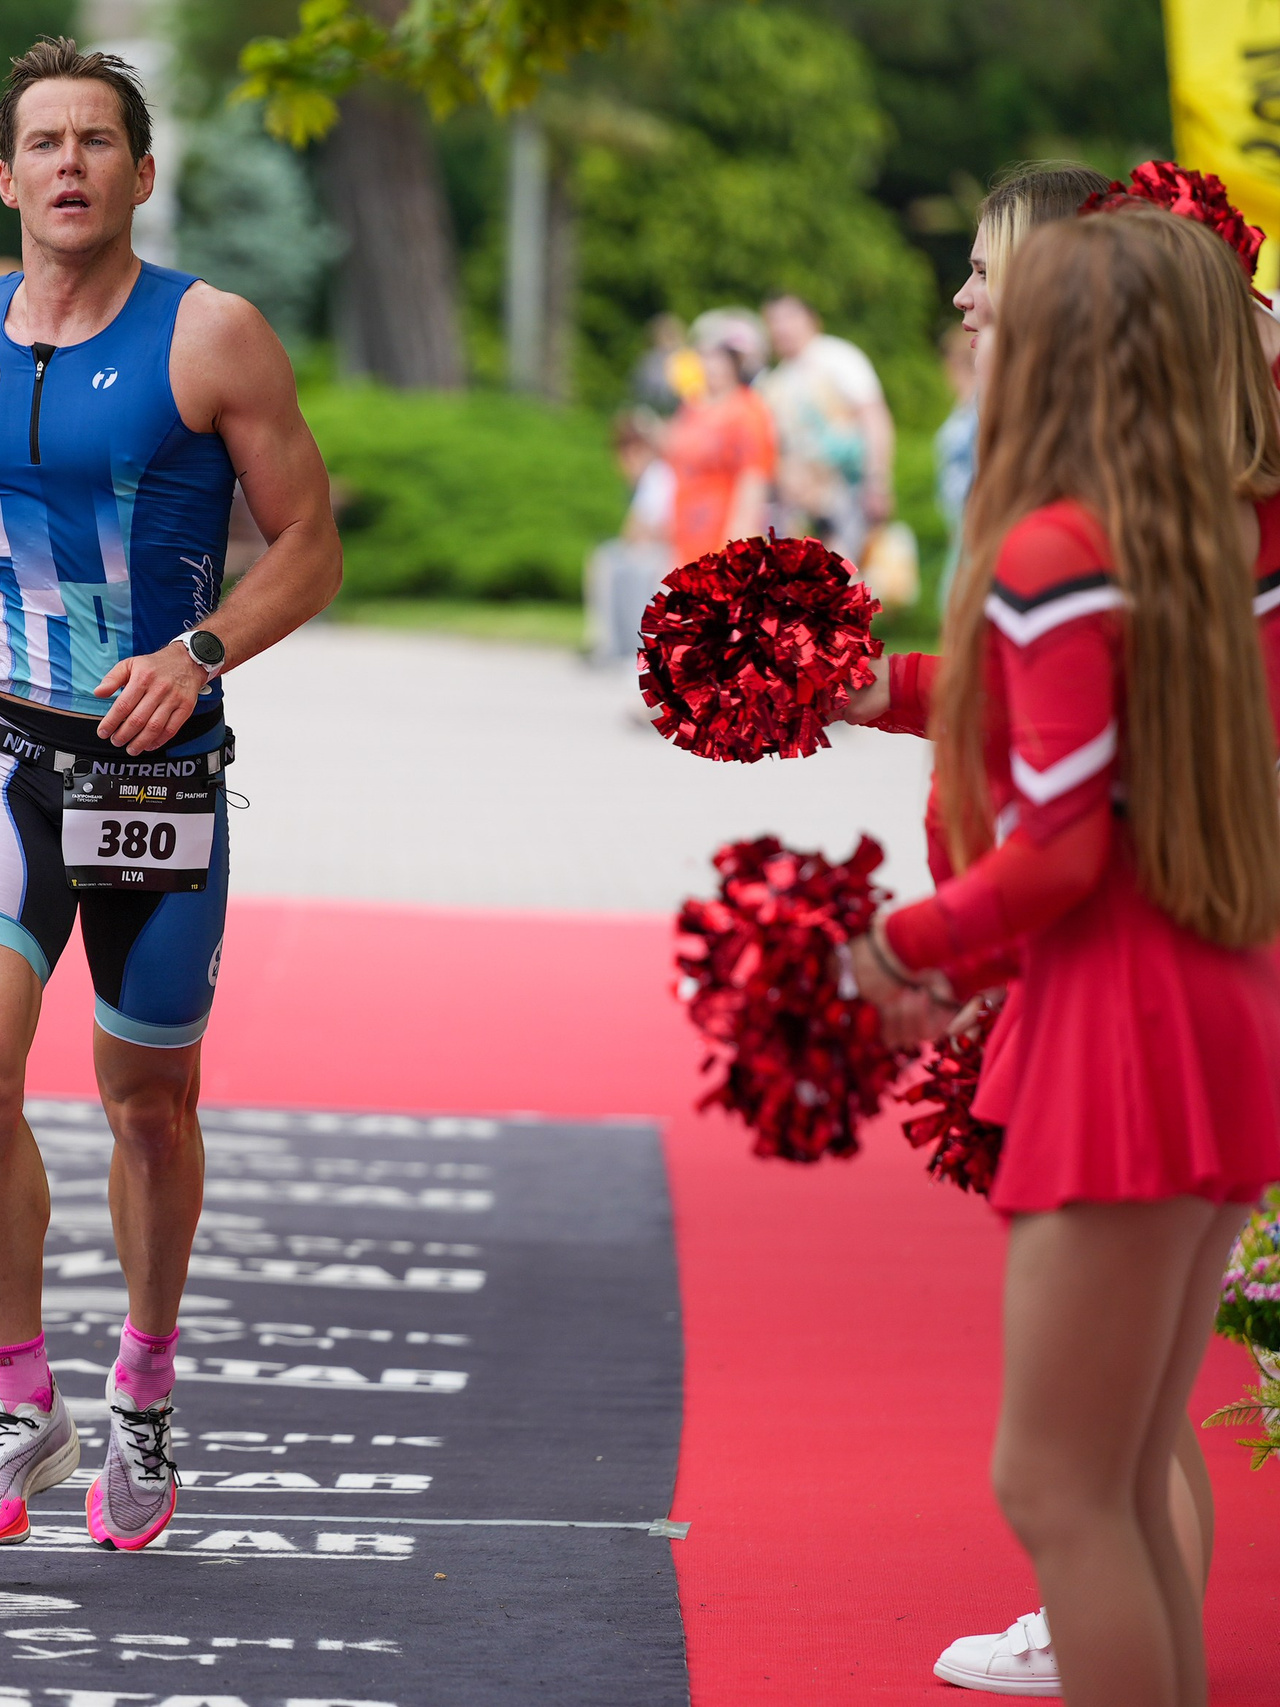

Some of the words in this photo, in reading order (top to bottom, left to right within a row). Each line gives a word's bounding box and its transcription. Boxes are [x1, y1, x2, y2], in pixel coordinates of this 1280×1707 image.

[3, 732, 41, 760] NUT
[120, 785, 138, 795] IRON
[147, 785, 167, 797] STAR
[97, 820, 176, 860] 380
[121, 871, 144, 882] ILYA
